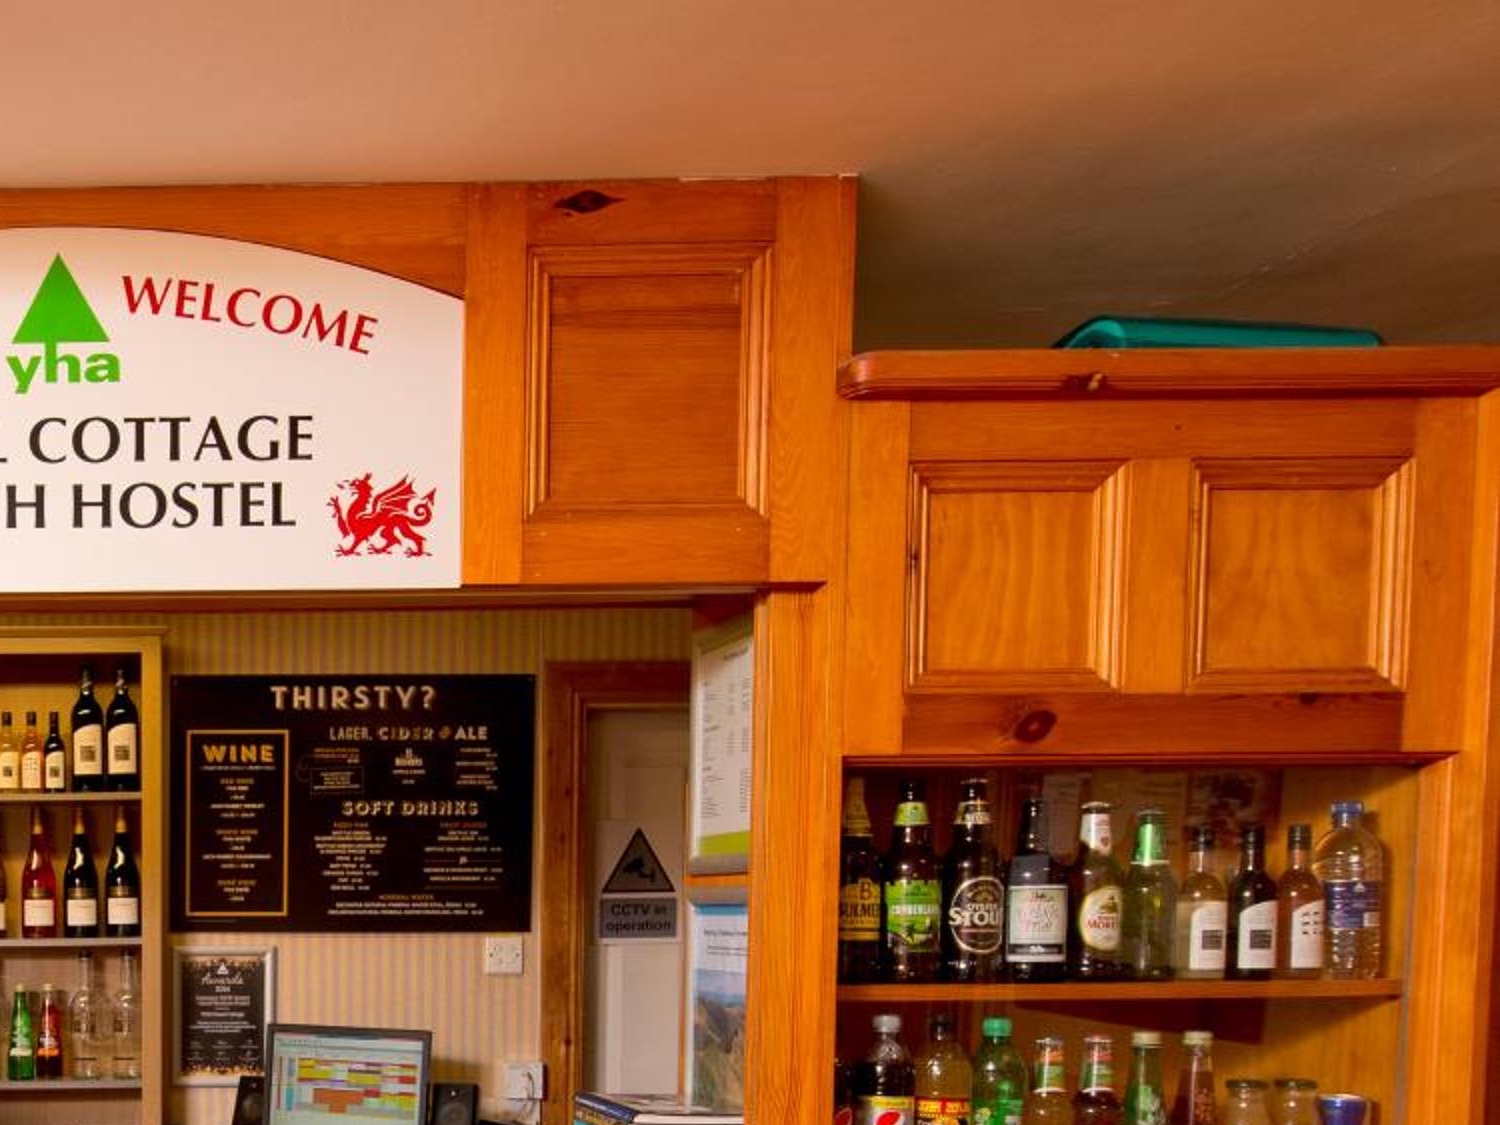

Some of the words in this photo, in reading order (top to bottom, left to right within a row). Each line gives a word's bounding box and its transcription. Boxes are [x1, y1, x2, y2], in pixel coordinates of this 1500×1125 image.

[121, 274, 379, 355] WELCOME
[6, 343, 121, 394] yha
[29, 414, 314, 464] COTTAGE
[72, 481, 297, 530] HOSTEL
[269, 685, 437, 710] THIRSTY?
[455, 726, 488, 740] ALE
[202, 744, 275, 763] WINE
[342, 800, 395, 816] SOFT
[402, 800, 479, 816] DRINKS
[611, 903, 651, 915] CCTV
[654, 903, 667, 914] in
[606, 920, 671, 934] operation
